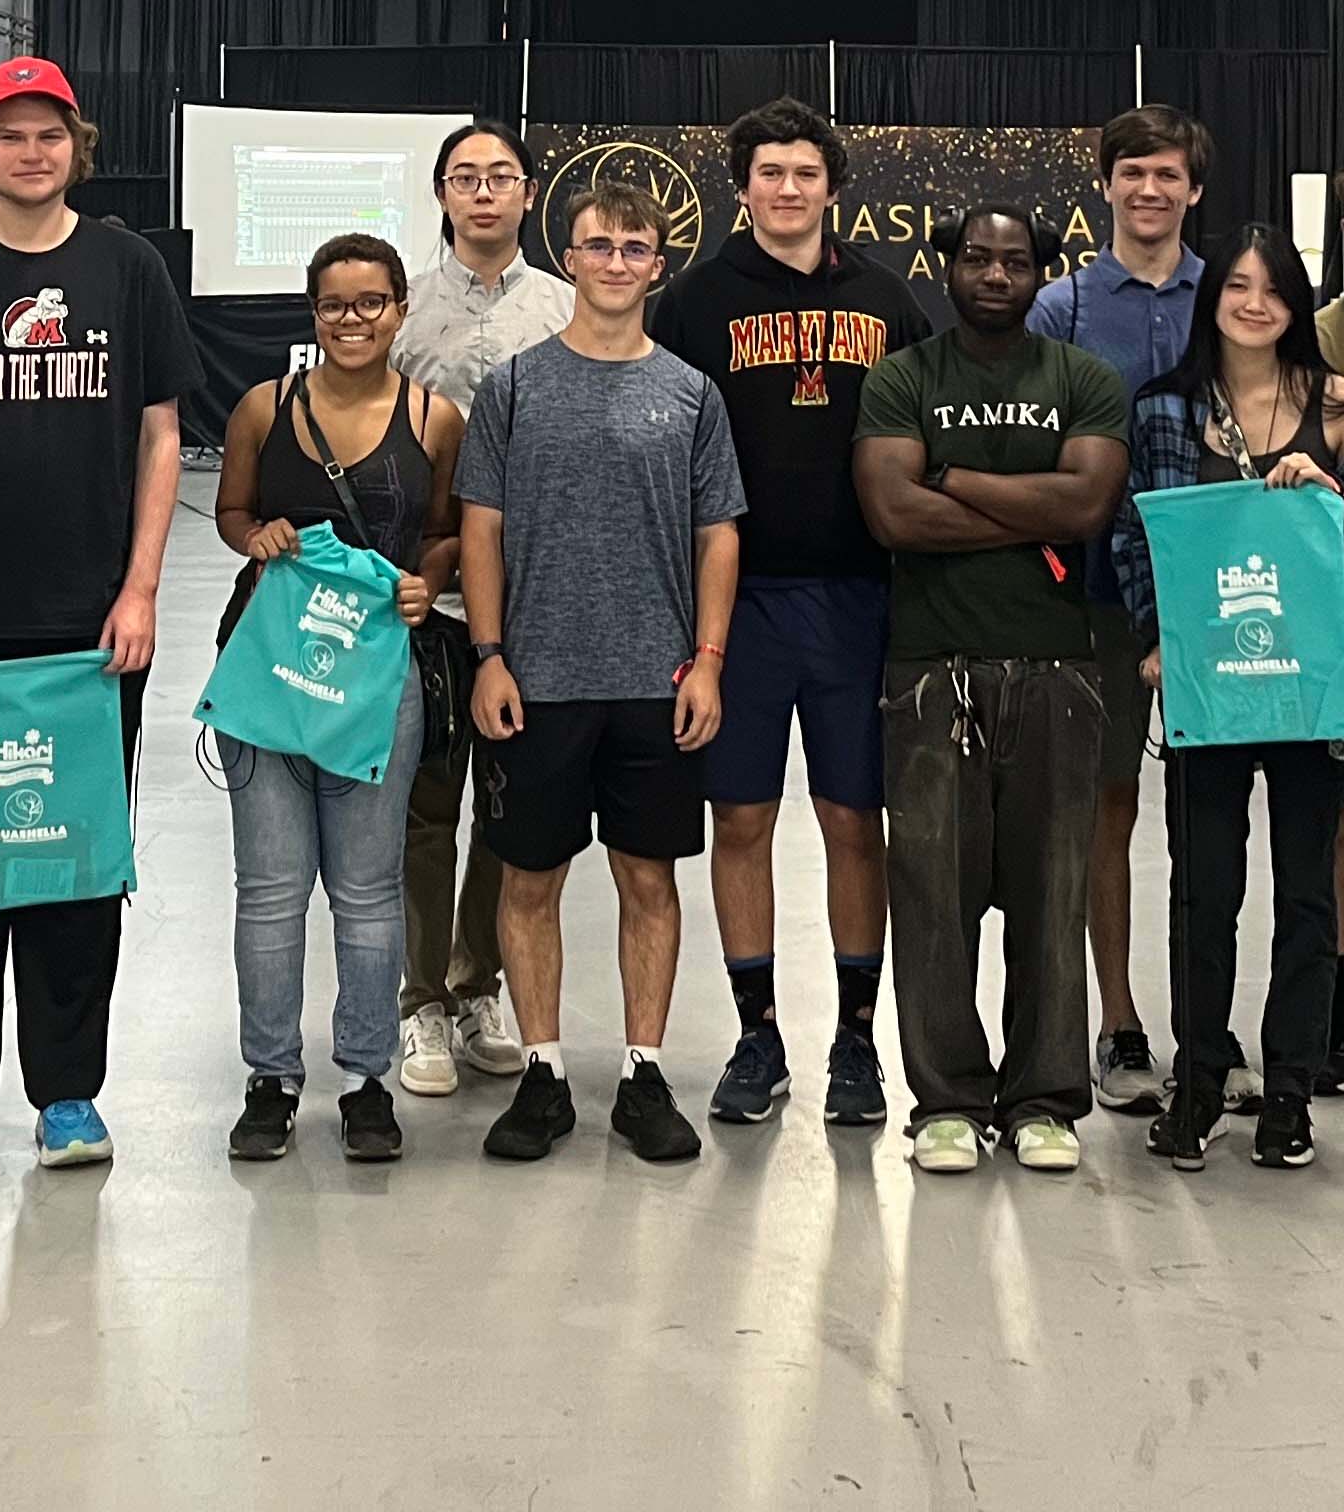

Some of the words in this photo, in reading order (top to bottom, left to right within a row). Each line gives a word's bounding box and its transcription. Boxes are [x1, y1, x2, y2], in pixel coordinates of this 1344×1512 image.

[25, 317, 65, 345] M
[8, 353, 40, 400] THE
[44, 351, 109, 399] TURTLE
[791, 365, 829, 406] M
[933, 402, 1061, 432] TAMIKA
[271, 663, 345, 702] AQUASHELLA
[1216, 658, 1301, 673] AQUASHELLA
